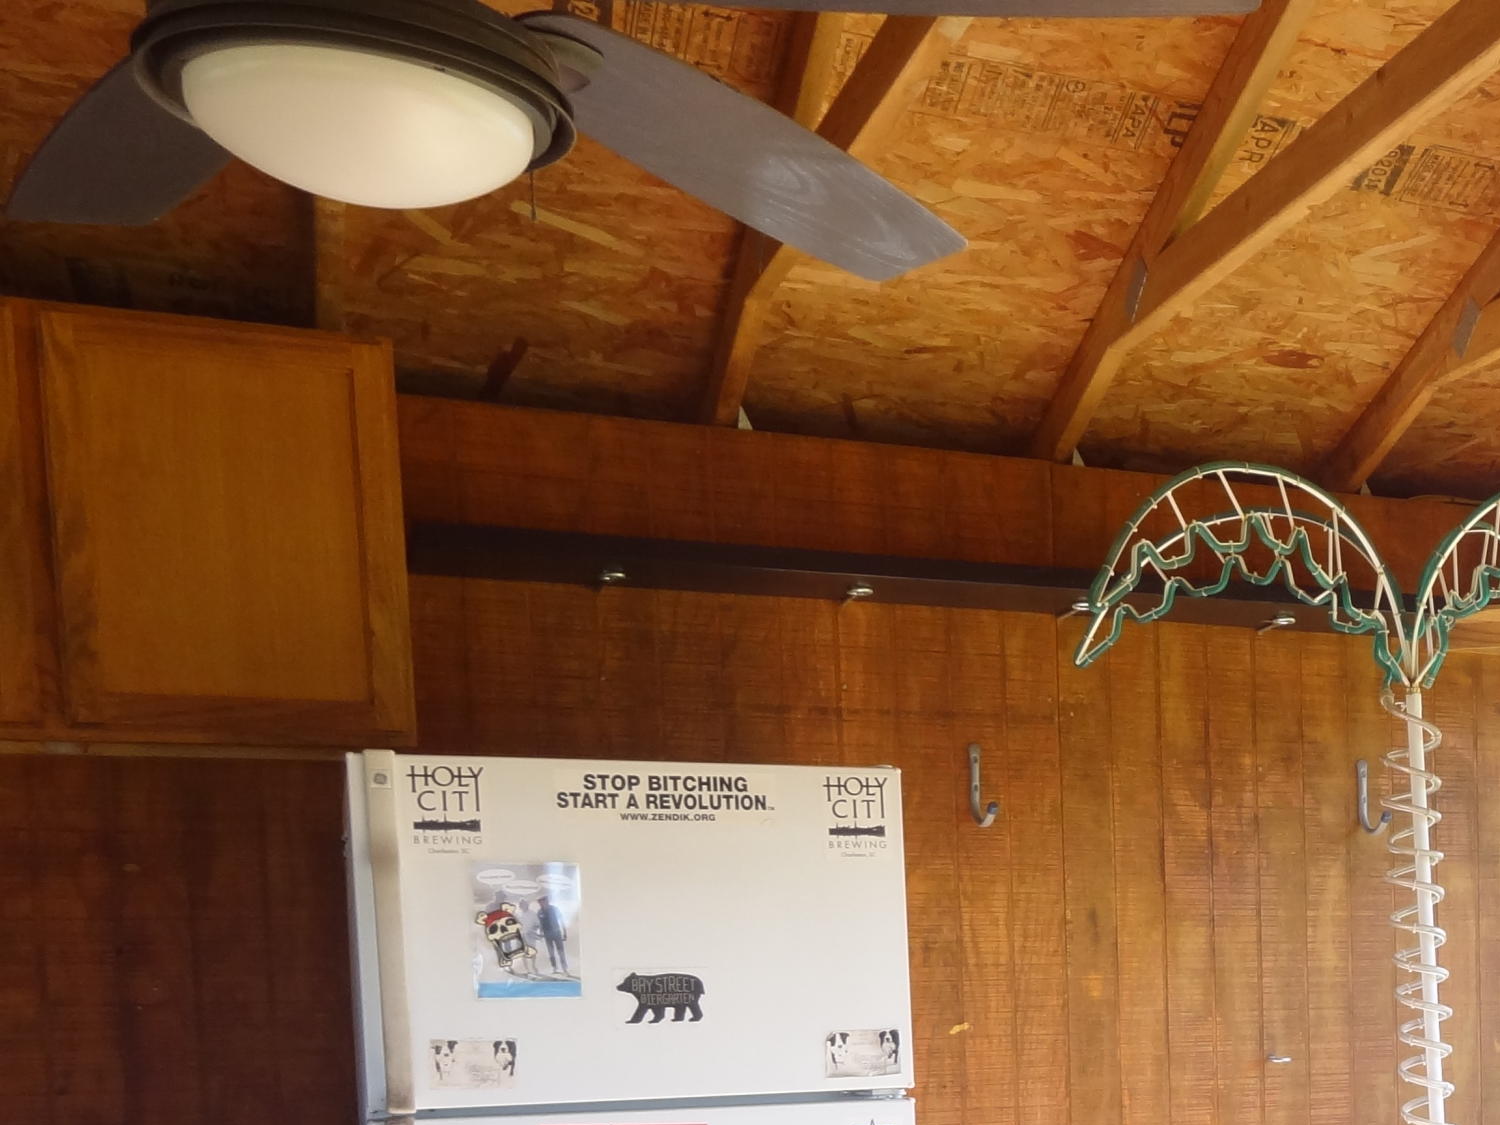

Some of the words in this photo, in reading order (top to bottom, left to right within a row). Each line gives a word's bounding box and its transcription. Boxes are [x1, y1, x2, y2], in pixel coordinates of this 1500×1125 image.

[405, 765, 484, 799] HOLY
[583, 774, 641, 791] STOP
[648, 775, 748, 792] BITCHING
[822, 776, 888, 805] HOLY
[556, 792, 619, 809] START
[626, 793, 640, 809] A
[646, 794, 767, 810] REVOLUTION
[620, 813, 716, 821] WWW.ZENDIK.ORG
[413, 835, 483, 845] BREWING
[828, 841, 888, 849] BREWING
[631, 977, 654, 993] BAY
[655, 975, 695, 993] STREET
